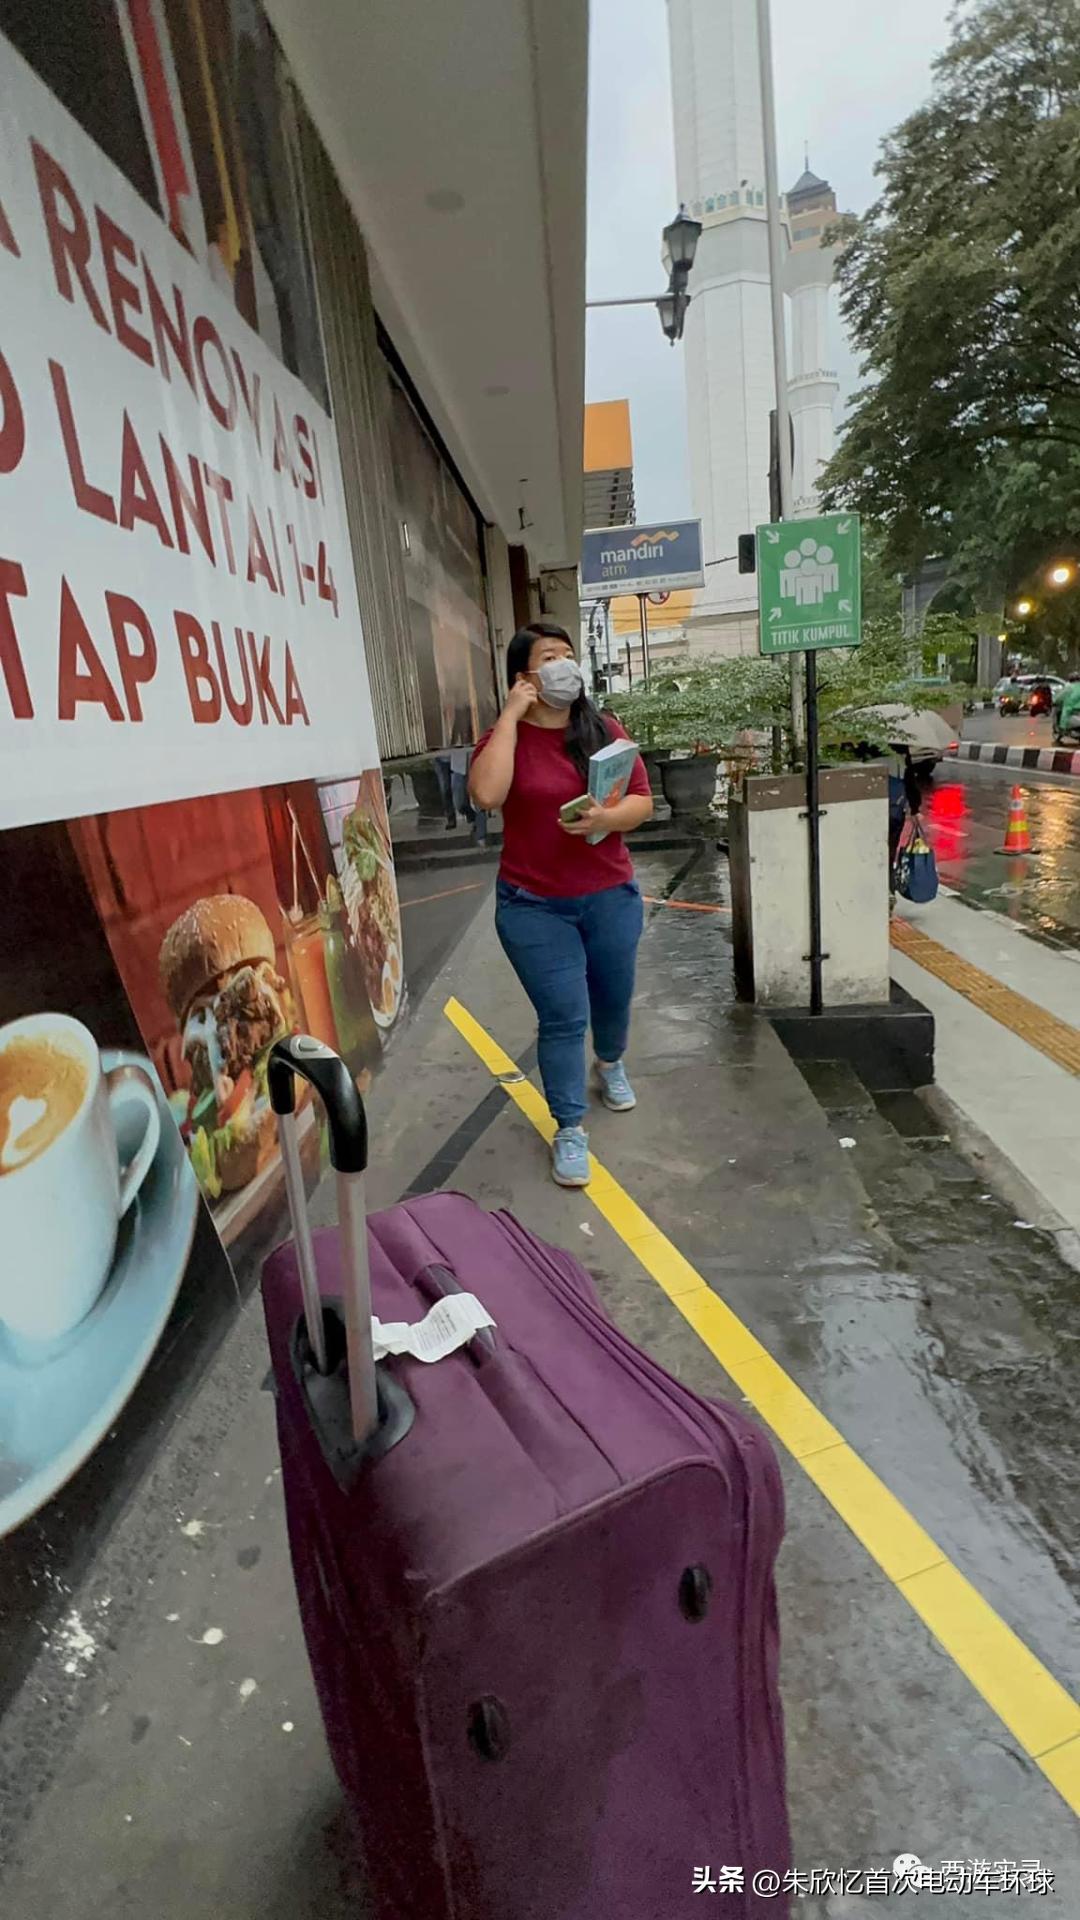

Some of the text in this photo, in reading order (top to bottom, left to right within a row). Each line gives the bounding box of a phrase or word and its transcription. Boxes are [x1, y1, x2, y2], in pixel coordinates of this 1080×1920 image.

[30, 134, 325, 506] RENOVASI
[48, 358, 285, 597] LANTAI
[286, 523, 339, 619] 1-4
[600, 542, 664, 564] mandiri
[602, 564, 627, 577] atm
[173, 609, 310, 727] BUKA
[771, 624, 850, 646] TITIK KUMPUL
